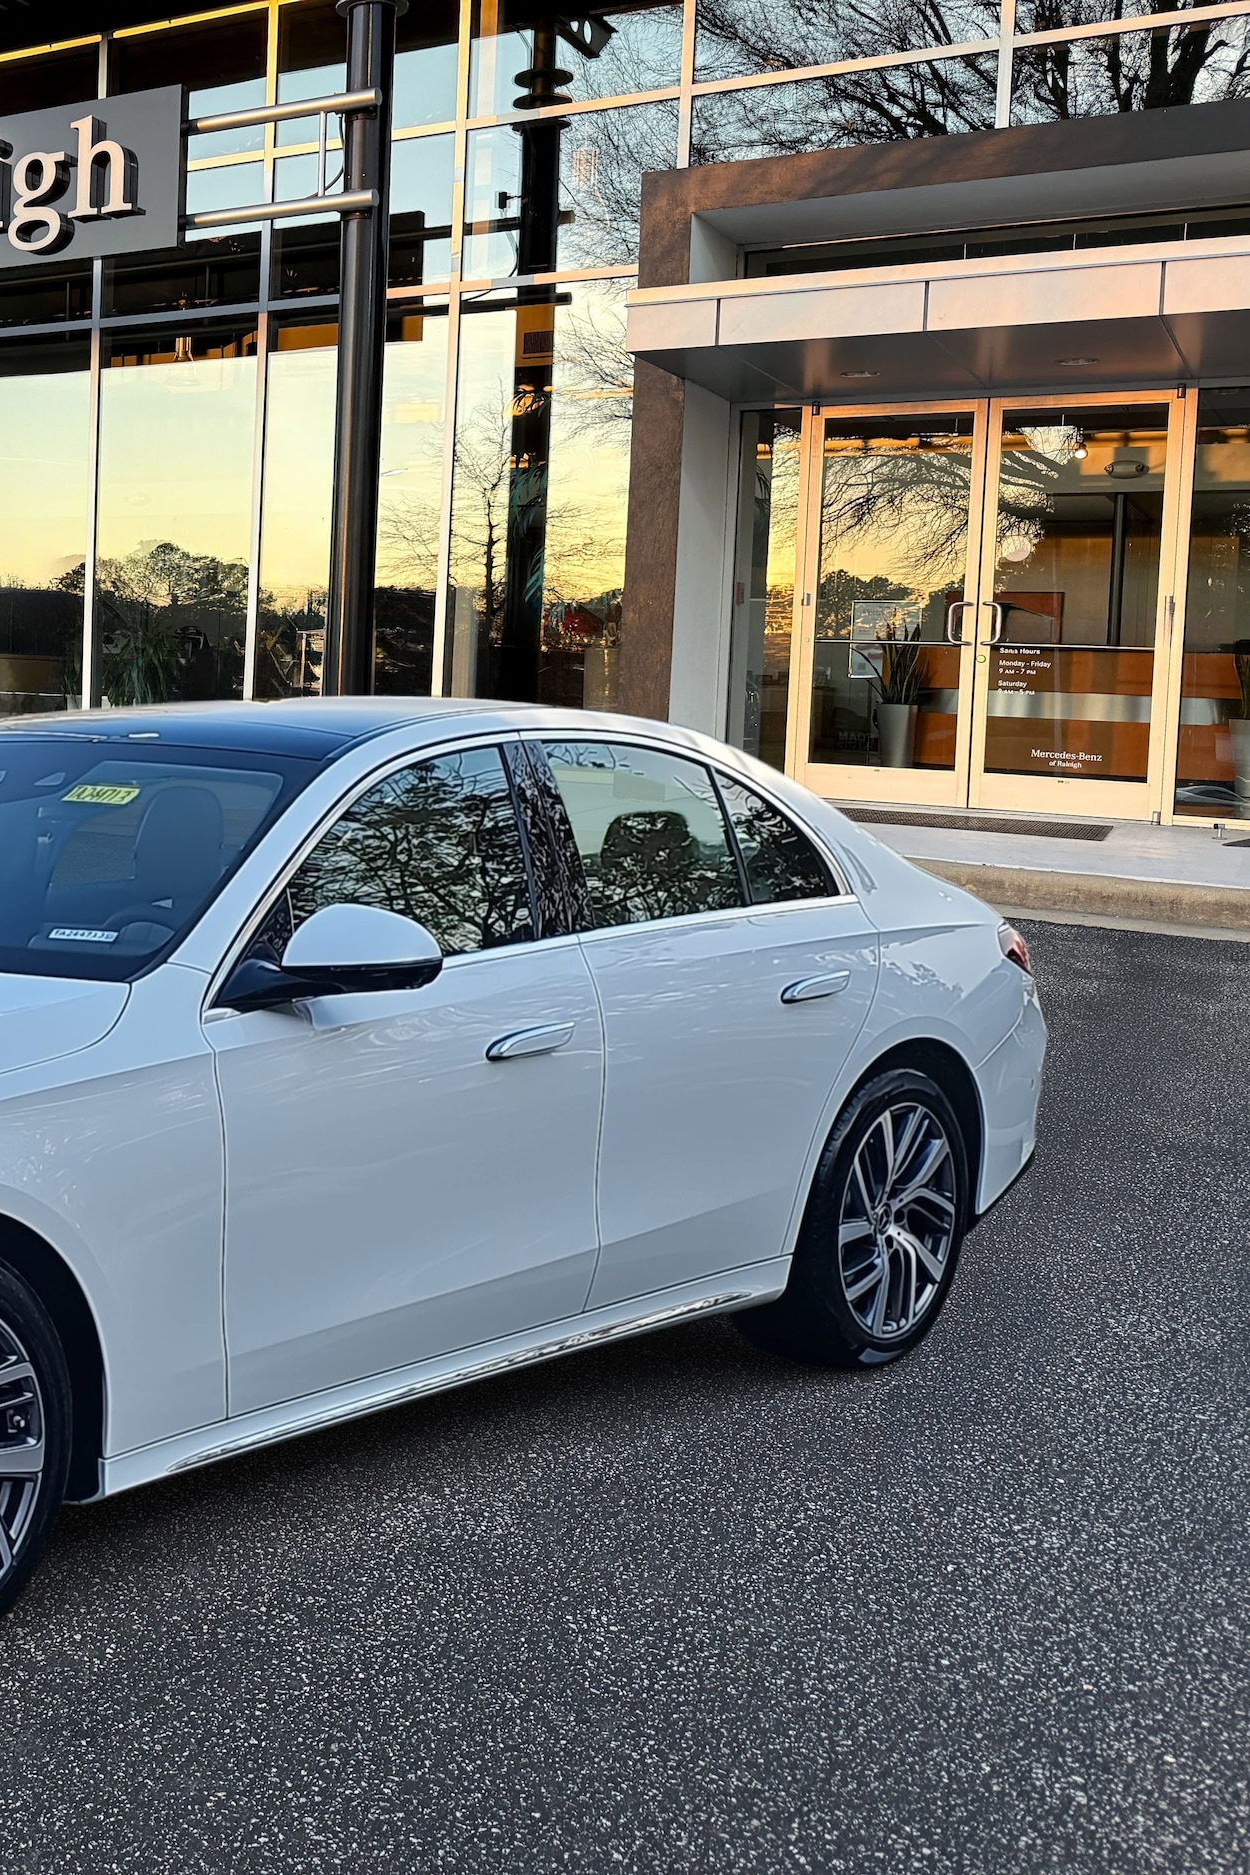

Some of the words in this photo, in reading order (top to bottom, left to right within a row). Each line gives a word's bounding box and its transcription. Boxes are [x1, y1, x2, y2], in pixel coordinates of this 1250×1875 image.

[998, 660, 1025, 668] Monday
[1030, 661, 1052, 669] Friday
[997, 680, 1028, 689] Saturday
[1030, 749, 1103, 761] Mercedes-Benz
[1057, 760, 1082, 769] Raleigh
